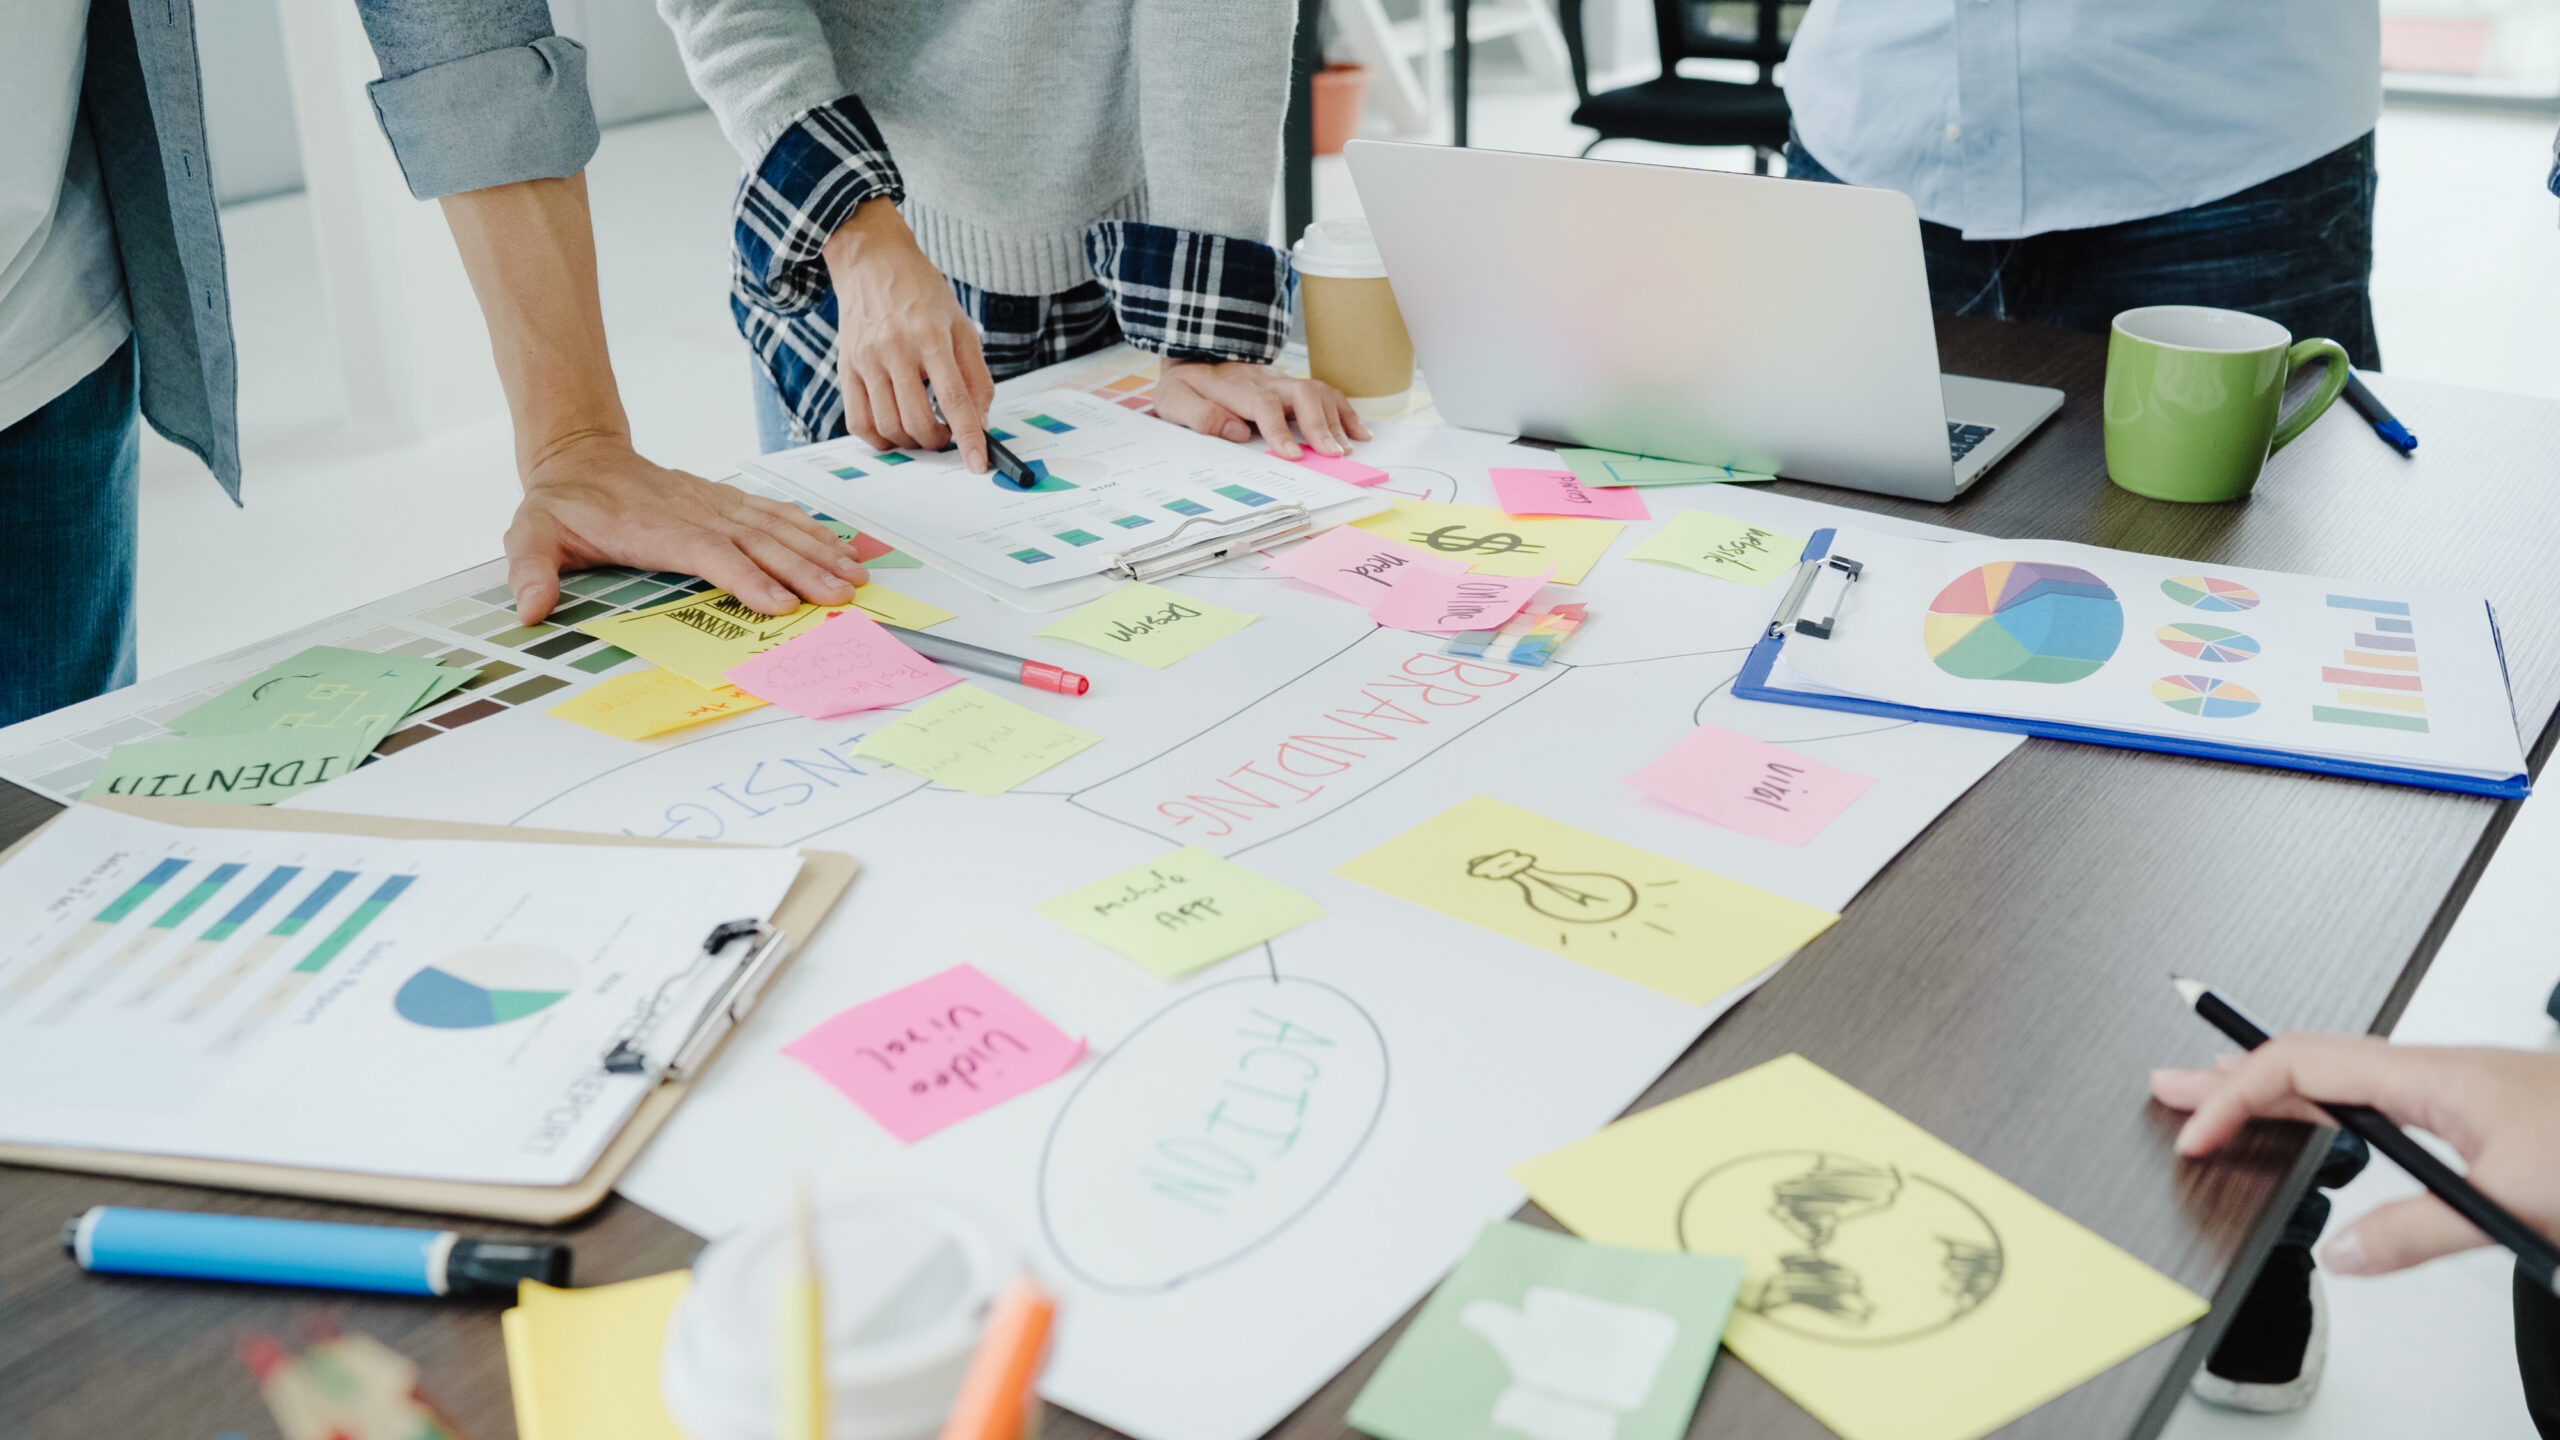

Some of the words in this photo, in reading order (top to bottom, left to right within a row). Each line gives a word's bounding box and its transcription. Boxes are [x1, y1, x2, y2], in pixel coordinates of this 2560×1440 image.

[1105, 601, 1203, 645] Design
[622, 731, 893, 838] NSIG
[1156, 651, 1520, 837] BRANDING
[519, 1066, 607, 1156] EPORT
[1139, 1007, 1337, 1216] ACTION
